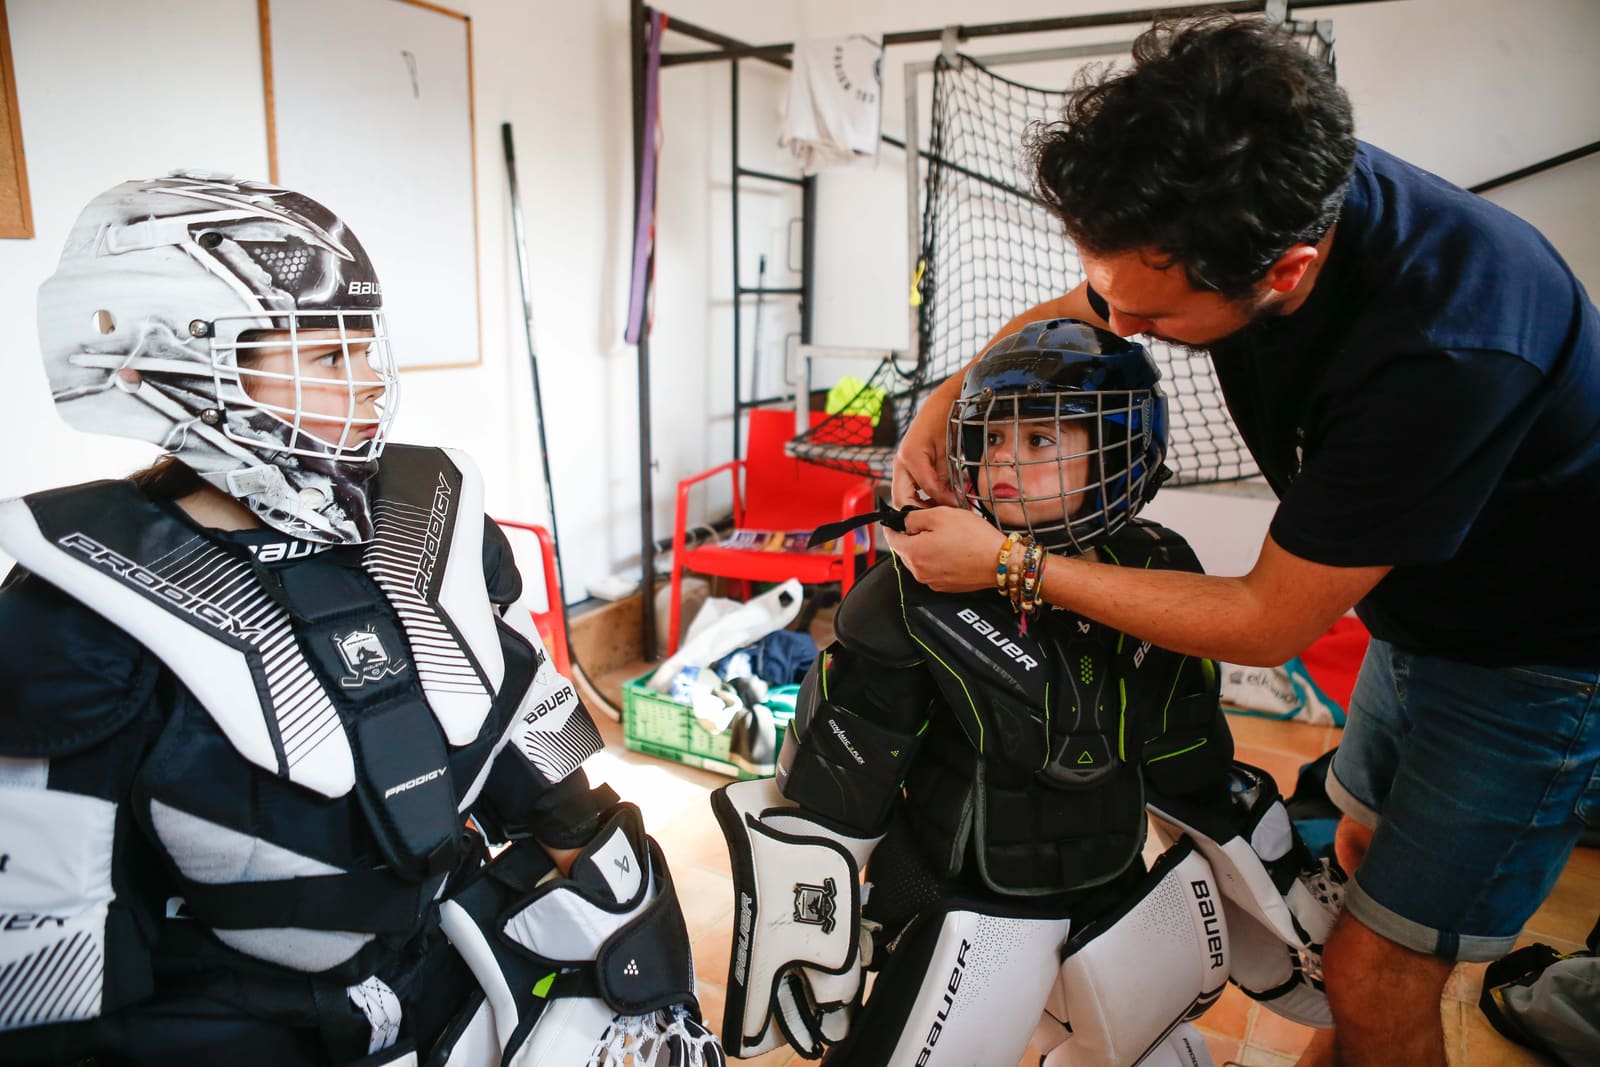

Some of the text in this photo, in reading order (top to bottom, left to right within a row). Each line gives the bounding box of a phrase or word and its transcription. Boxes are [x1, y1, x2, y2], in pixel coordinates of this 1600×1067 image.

[348, 281, 383, 295] BAU
[413, 471, 452, 601] PRODIGY
[58, 532, 264, 640] PRODIGY
[957, 608, 1039, 671] BAUER
[522, 685, 574, 725] BAUER
[384, 766, 447, 799] PRODIGY
[734, 891, 753, 987] BAUER
[1190, 879, 1224, 971] BAUER
[914, 938, 972, 1067] BAUER
